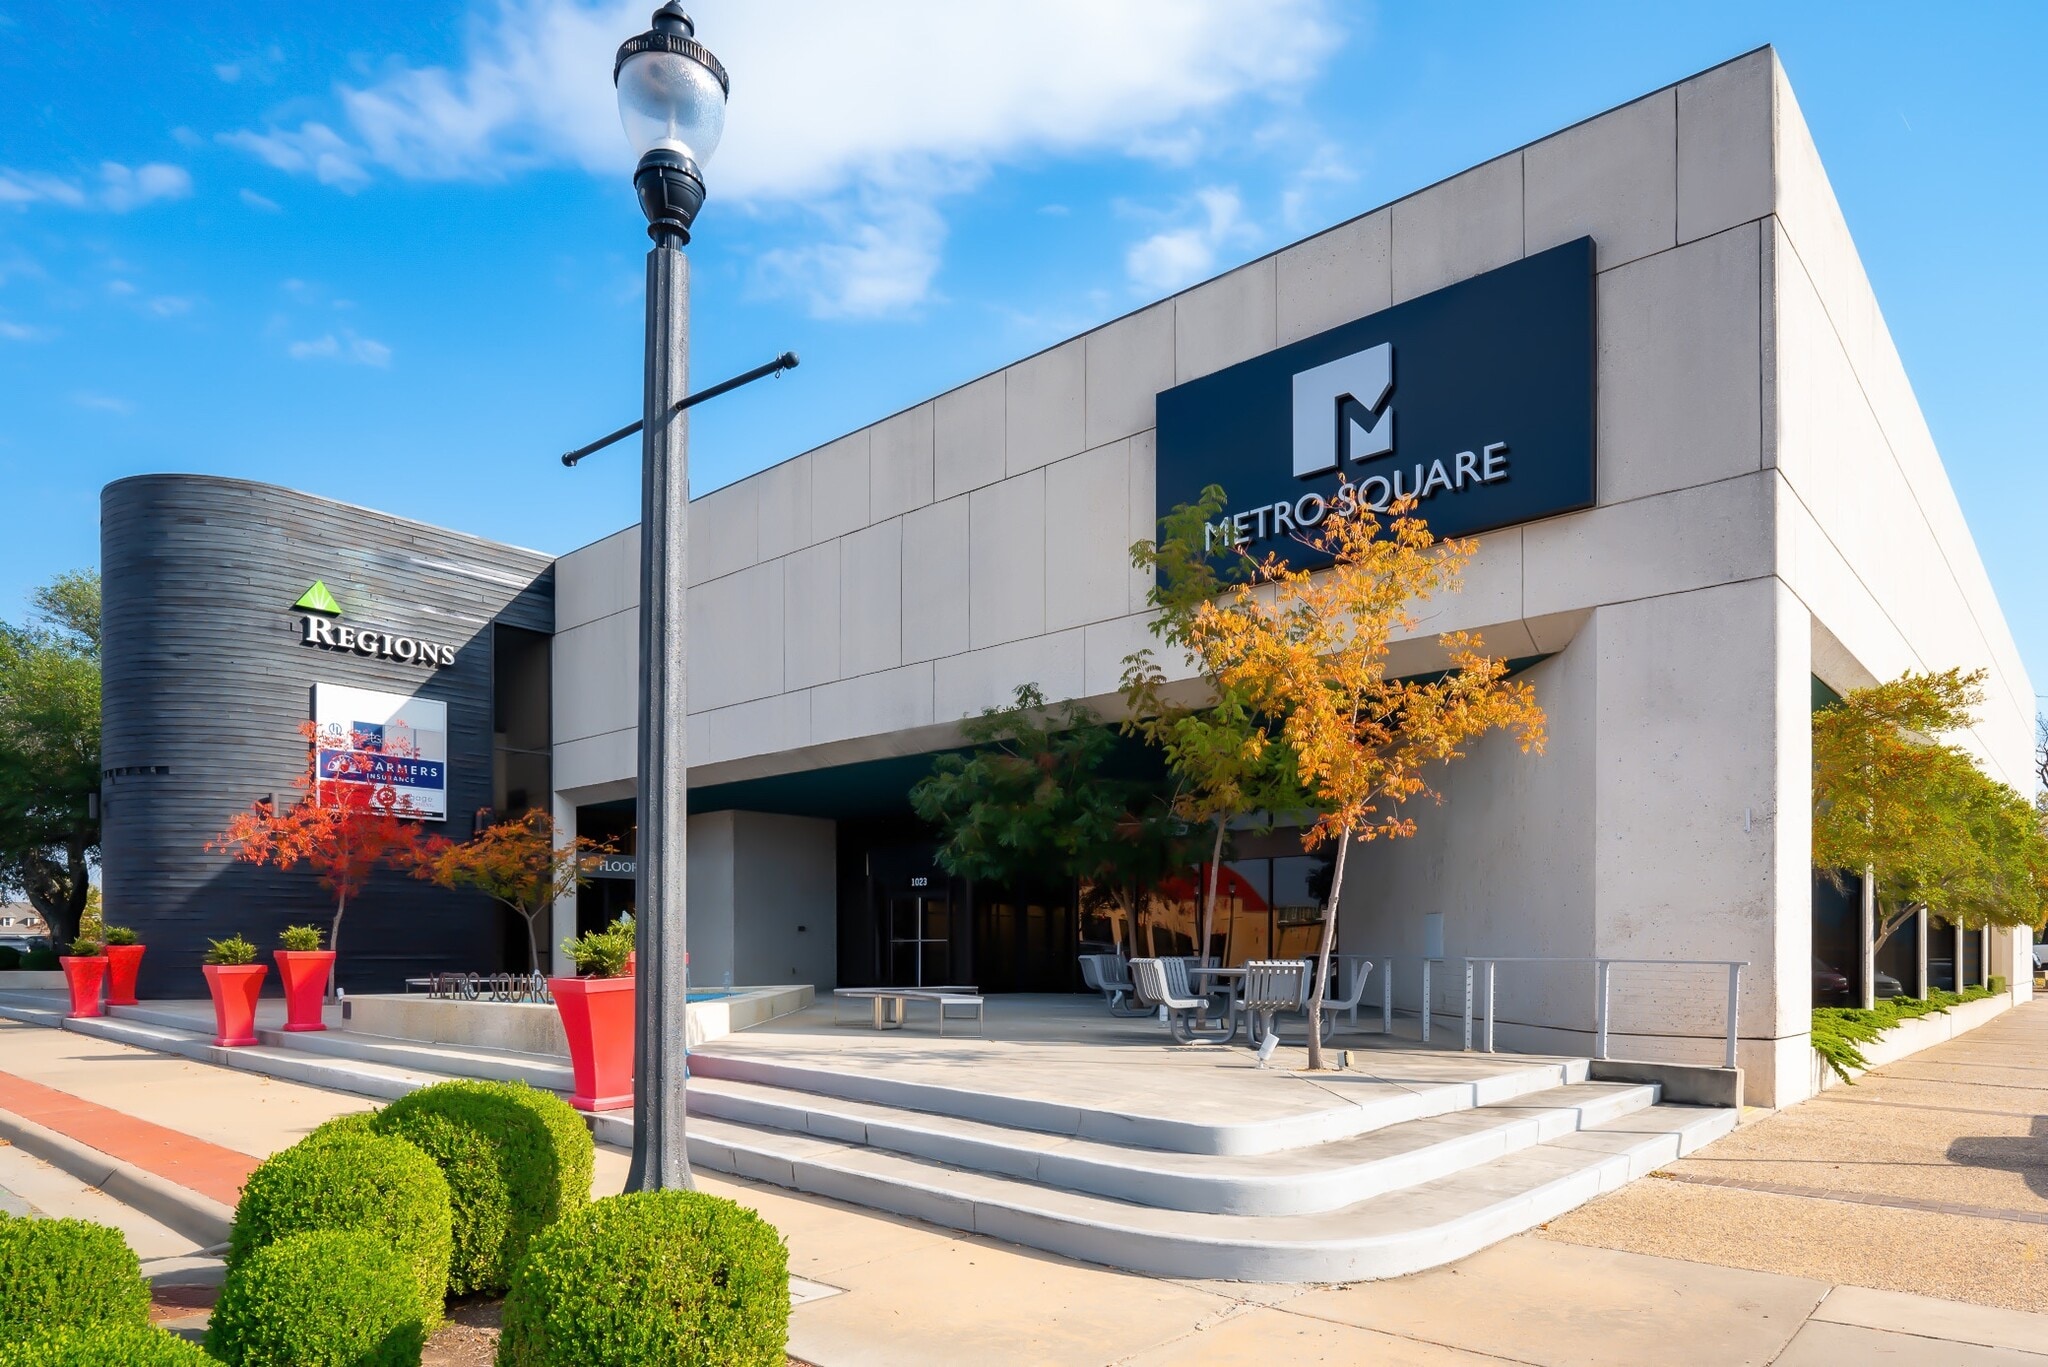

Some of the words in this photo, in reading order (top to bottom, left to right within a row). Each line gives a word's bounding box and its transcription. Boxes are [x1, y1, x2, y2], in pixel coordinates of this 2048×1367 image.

[1204, 492, 1326, 551] METRO
[1337, 441, 1507, 518] SQUARE
[305, 615, 455, 665] REGIONS
[368, 761, 438, 777] ARMERS
[911, 877, 928, 887] 1023
